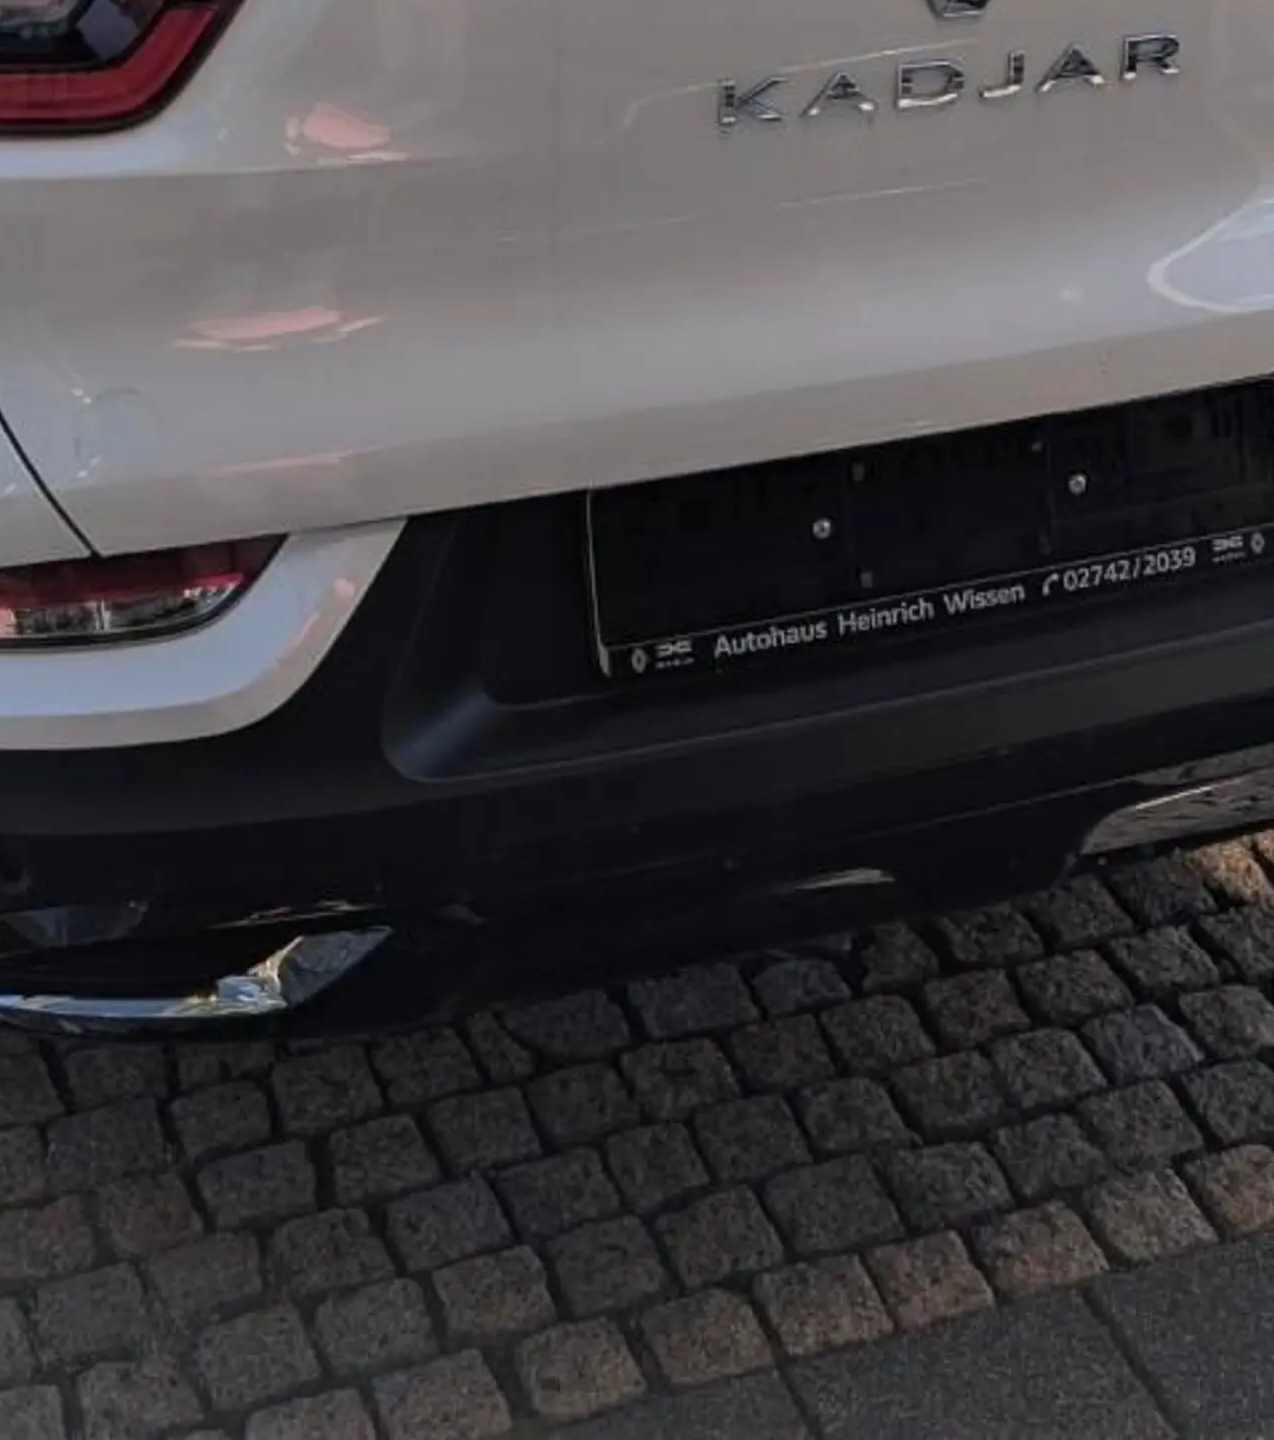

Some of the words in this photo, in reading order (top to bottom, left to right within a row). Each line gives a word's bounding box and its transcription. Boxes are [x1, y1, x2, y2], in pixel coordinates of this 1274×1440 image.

[718, 34, 1181, 124] KADJAR
[714, 620, 827, 659] Autohaus
[838, 597, 934, 635] Heinrich
[943, 584, 1025, 616] Wissen
[1063, 547, 1197, 592] 02742/2039
